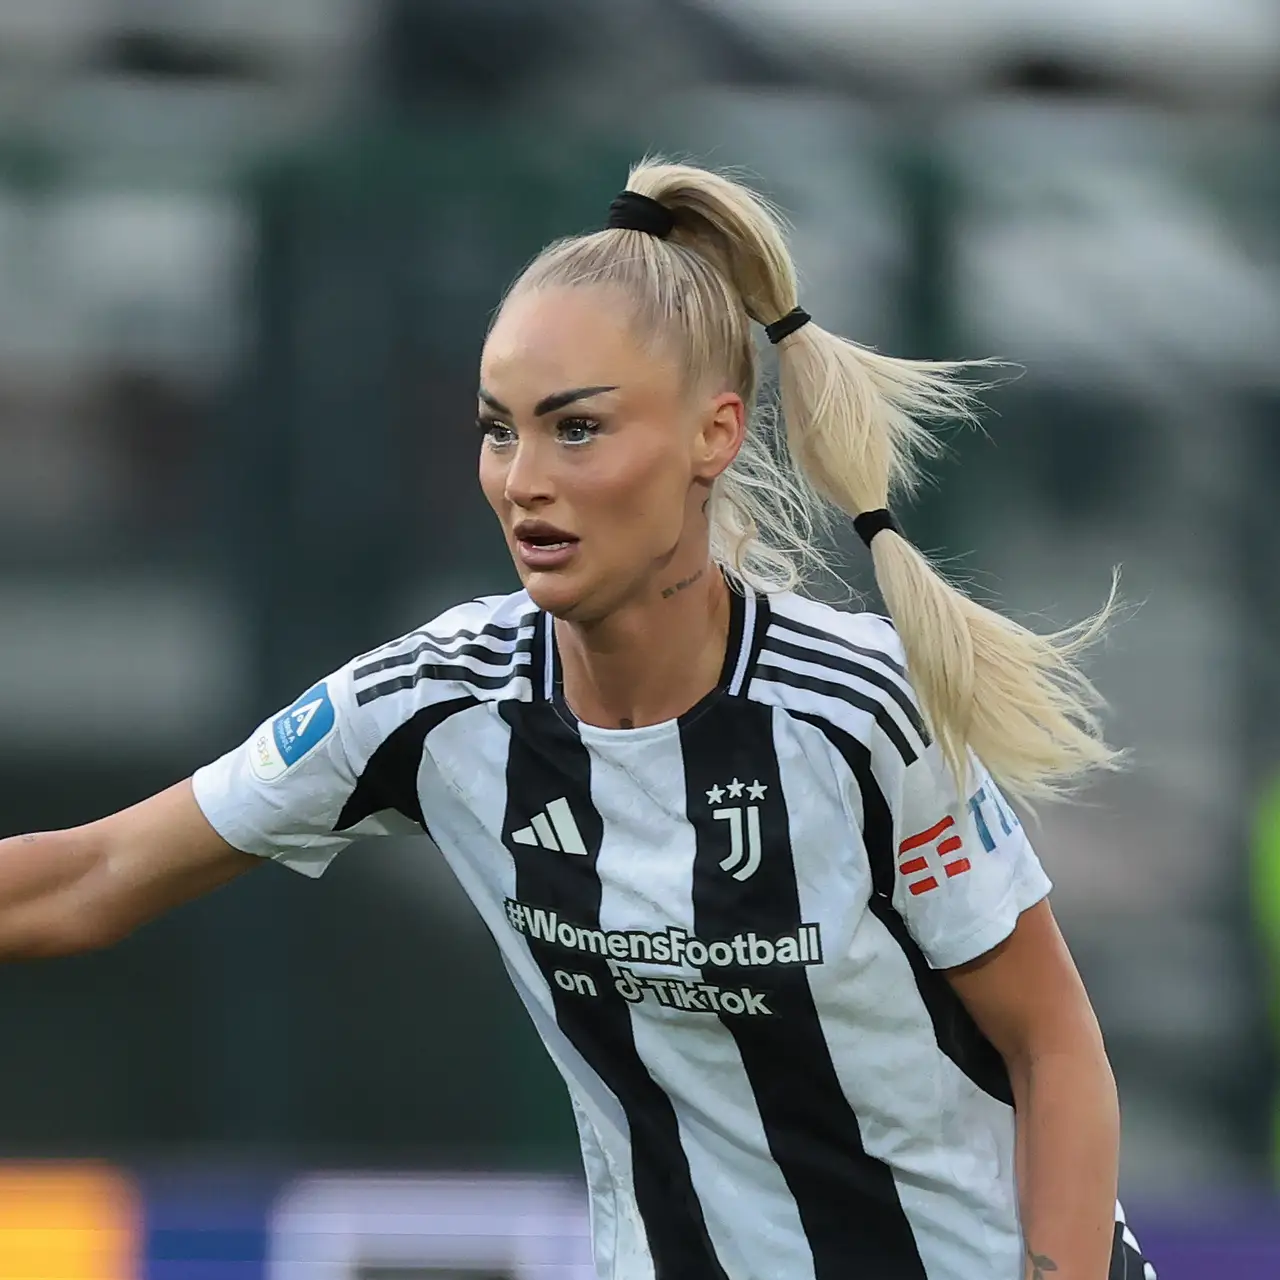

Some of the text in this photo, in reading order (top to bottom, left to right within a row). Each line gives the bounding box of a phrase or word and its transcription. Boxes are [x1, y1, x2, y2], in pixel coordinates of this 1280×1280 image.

[505, 900, 821, 967] #WomensFootball
[554, 968, 773, 1015] on TikTok
